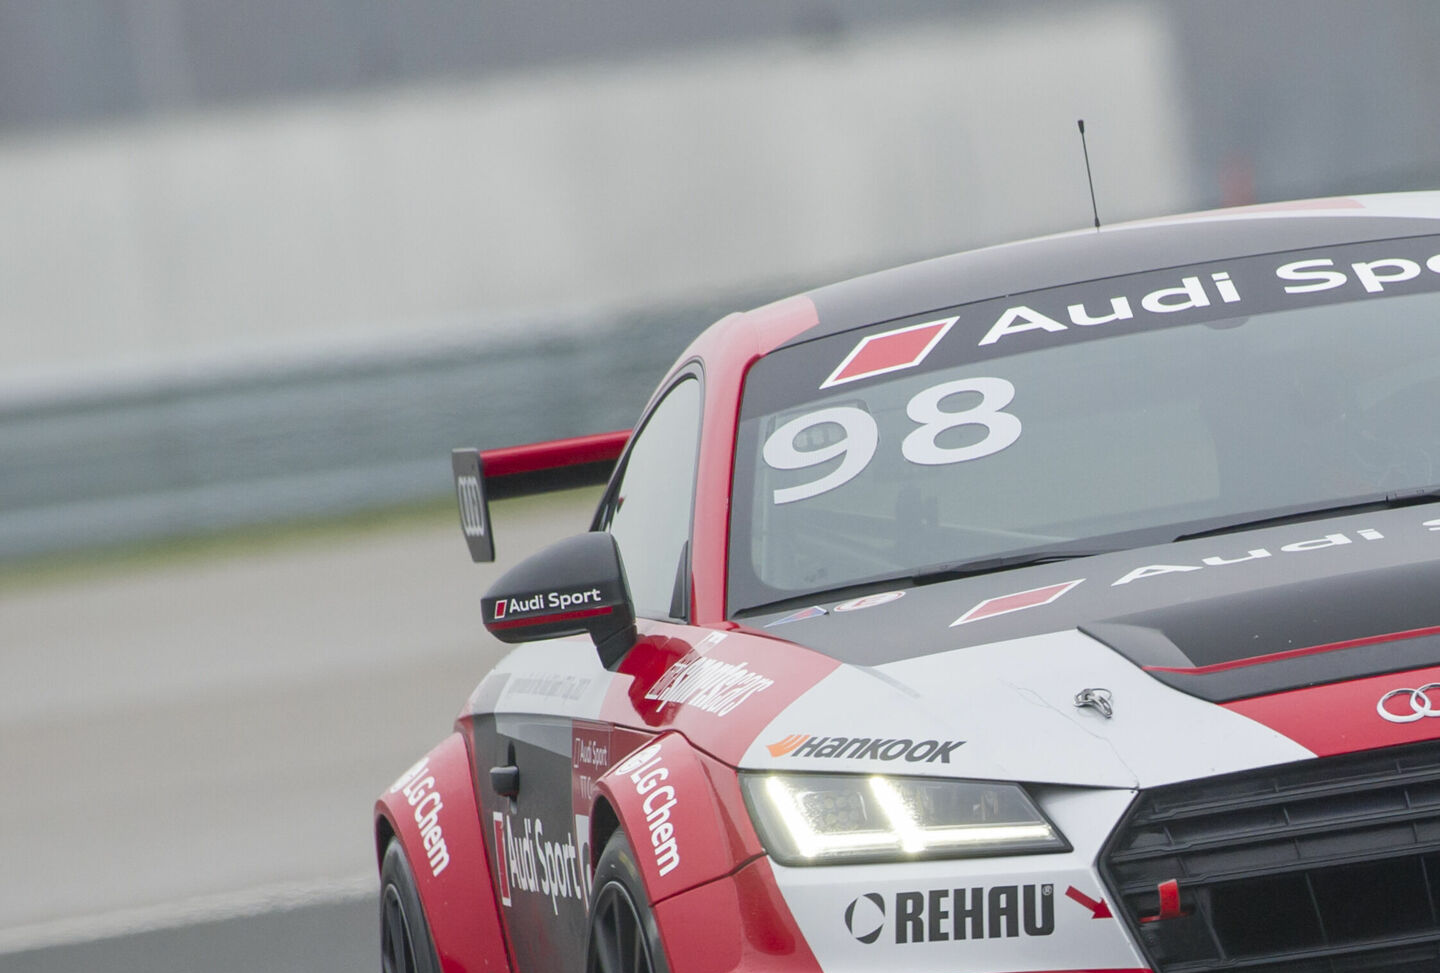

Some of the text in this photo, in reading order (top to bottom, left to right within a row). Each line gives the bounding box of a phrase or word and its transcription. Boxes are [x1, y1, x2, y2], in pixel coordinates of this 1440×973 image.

[978, 272, 1241, 346] Audi
[762, 377, 1022, 504] 98
[509, 588, 602, 614] Audi Sport
[1111, 528, 1385, 587] Audi
[402, 767, 450, 878] LG Chem
[630, 756, 681, 877] LG Chem
[506, 814, 540, 893] Audi
[534, 817, 582, 916] Sport
[894, 883, 1055, 945] REHAU
